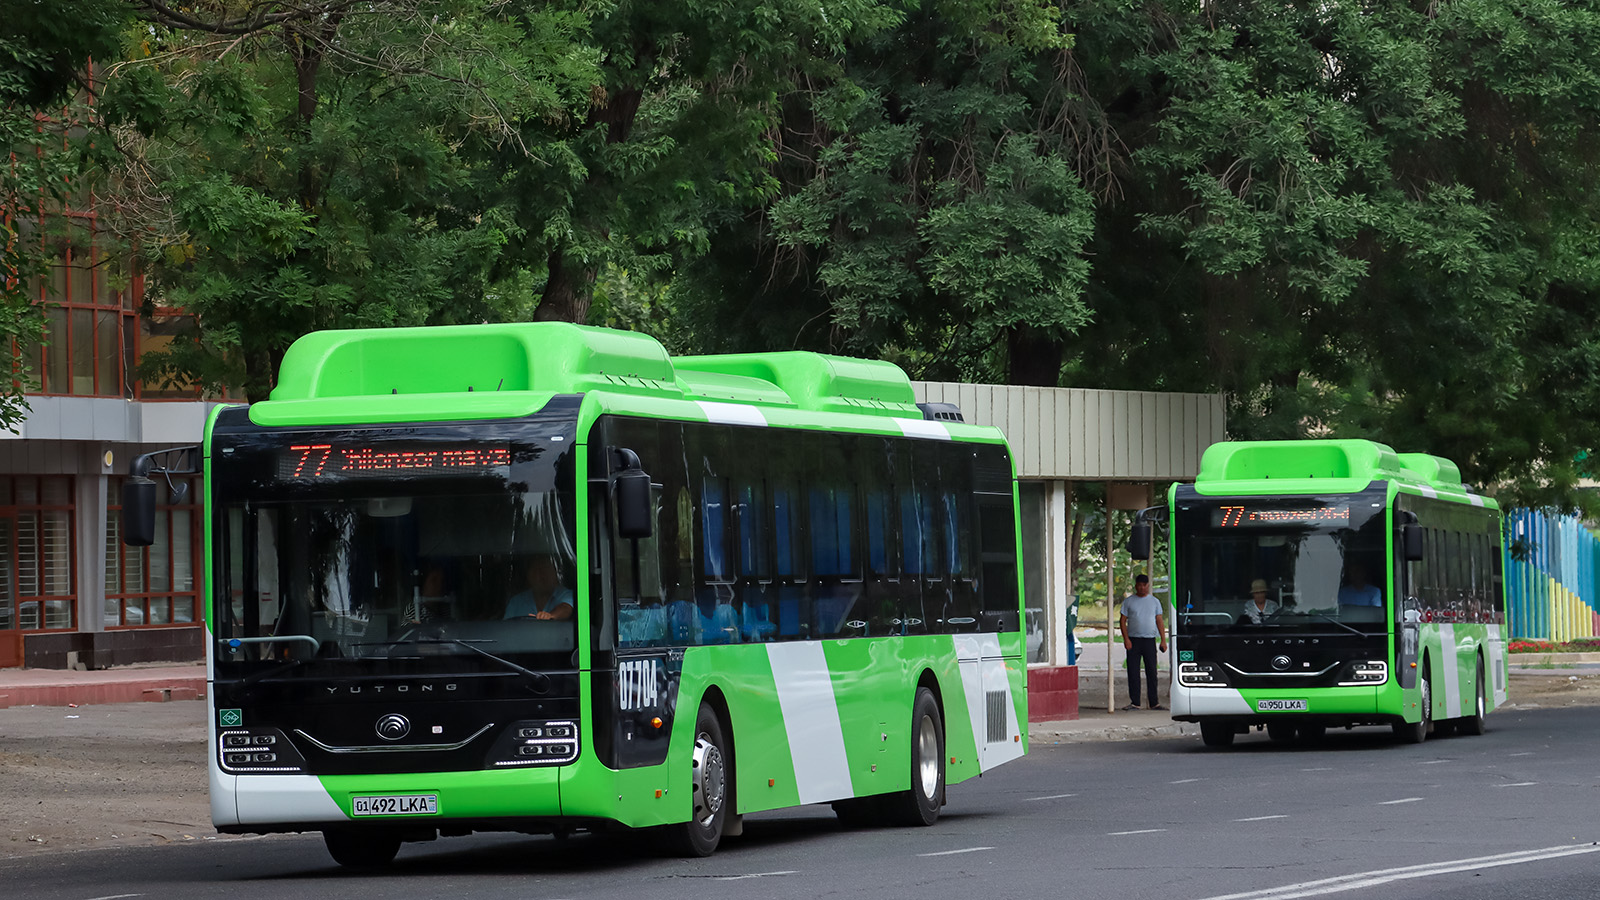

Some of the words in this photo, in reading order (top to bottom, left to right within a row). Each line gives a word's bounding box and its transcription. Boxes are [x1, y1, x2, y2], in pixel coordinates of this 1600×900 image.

[290, 444, 331, 477] 77
[443, 449, 510, 467] mavz
[1220, 505, 1245, 527] 77
[327, 683, 457, 694] YUTONG
[619, 659, 658, 710] 07704
[1268, 701, 1283, 709] 950
[1284, 700, 1302, 709] LKA
[356, 800, 369, 812] 01
[371, 798, 397, 813] 492
[399, 797, 428, 812] LKA
